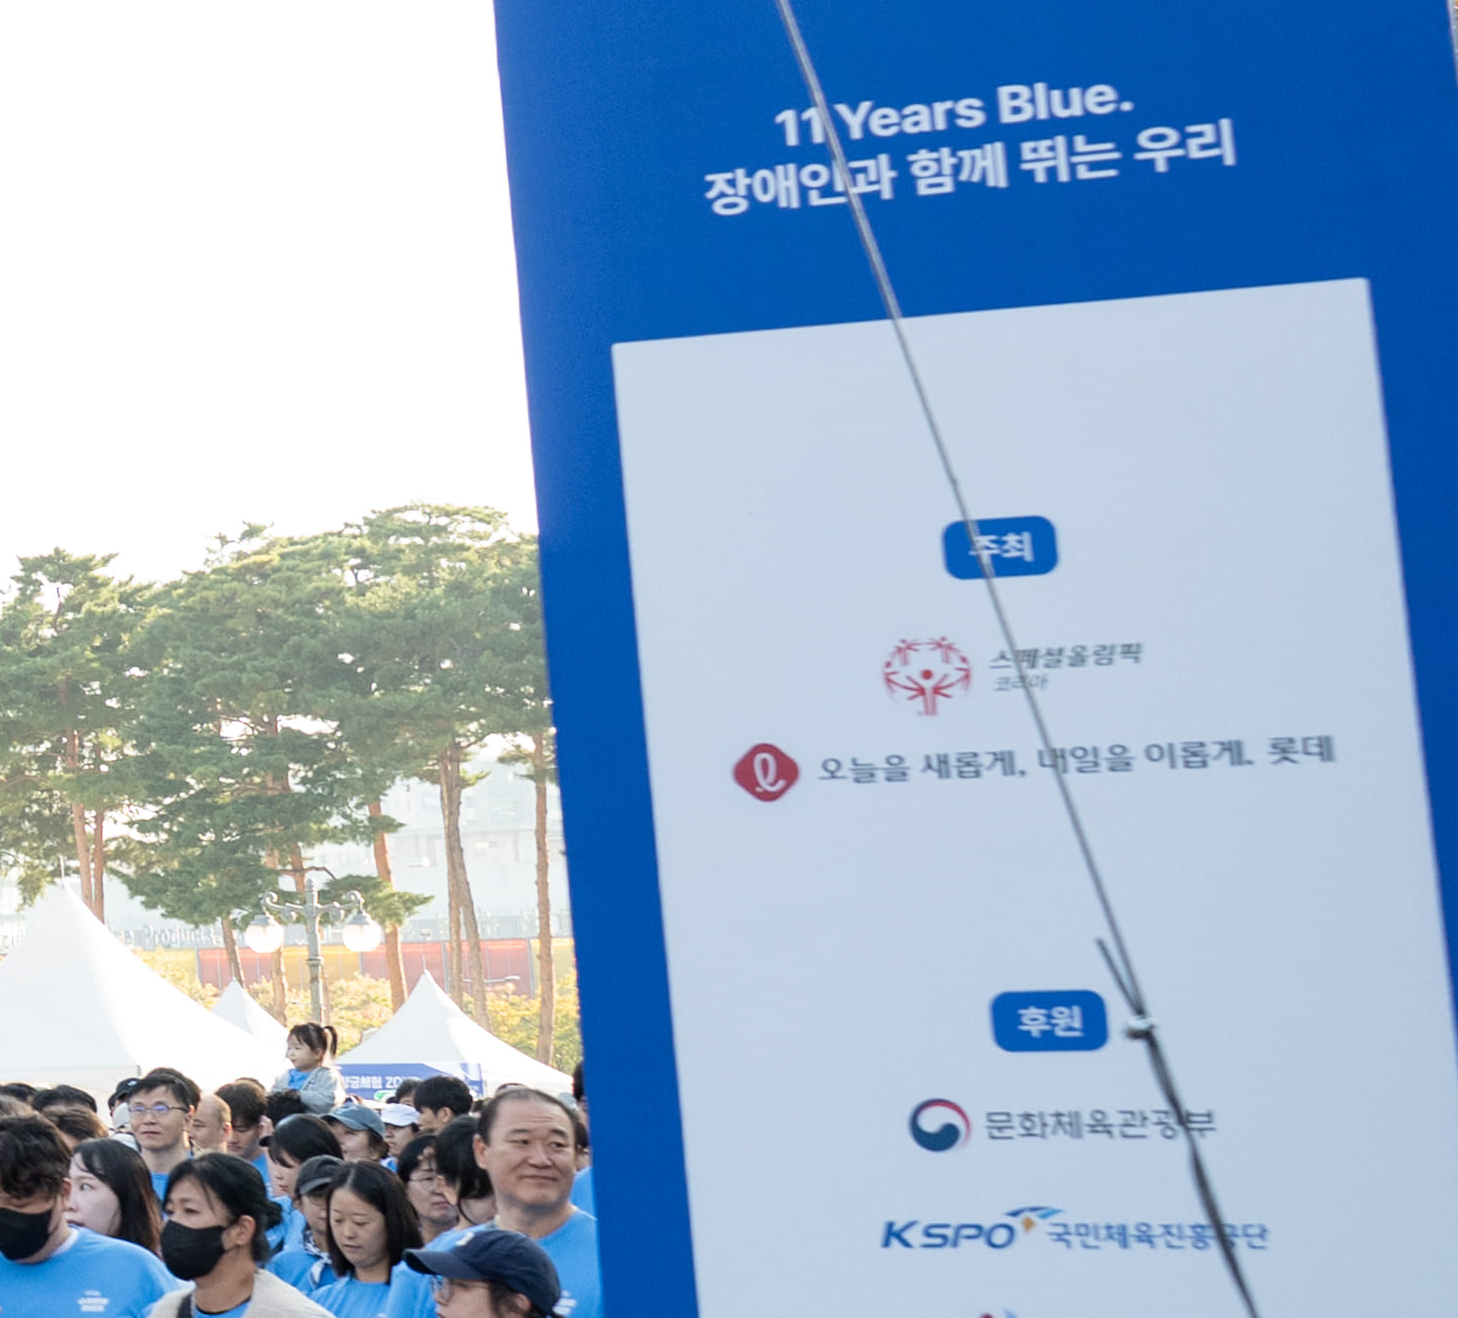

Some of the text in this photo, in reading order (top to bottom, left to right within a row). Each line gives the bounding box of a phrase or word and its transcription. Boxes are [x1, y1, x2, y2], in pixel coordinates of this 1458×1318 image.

[775, 80, 1133, 146] 11 Years Blue.
[705, 118, 1236, 215] 장애인과 함께 뛰는 우리
[968, 531, 1034, 563] 주최
[818, 756, 910, 785] 오늘을
[1037, 744, 1135, 776] 내일을
[1268, 734, 1337, 764] 롯데
[1018, 1006, 1084, 1038] 후원
[986, 1109, 1216, 1140] 문화체육관광부
[881, 1220, 1014, 1249] KSPO
